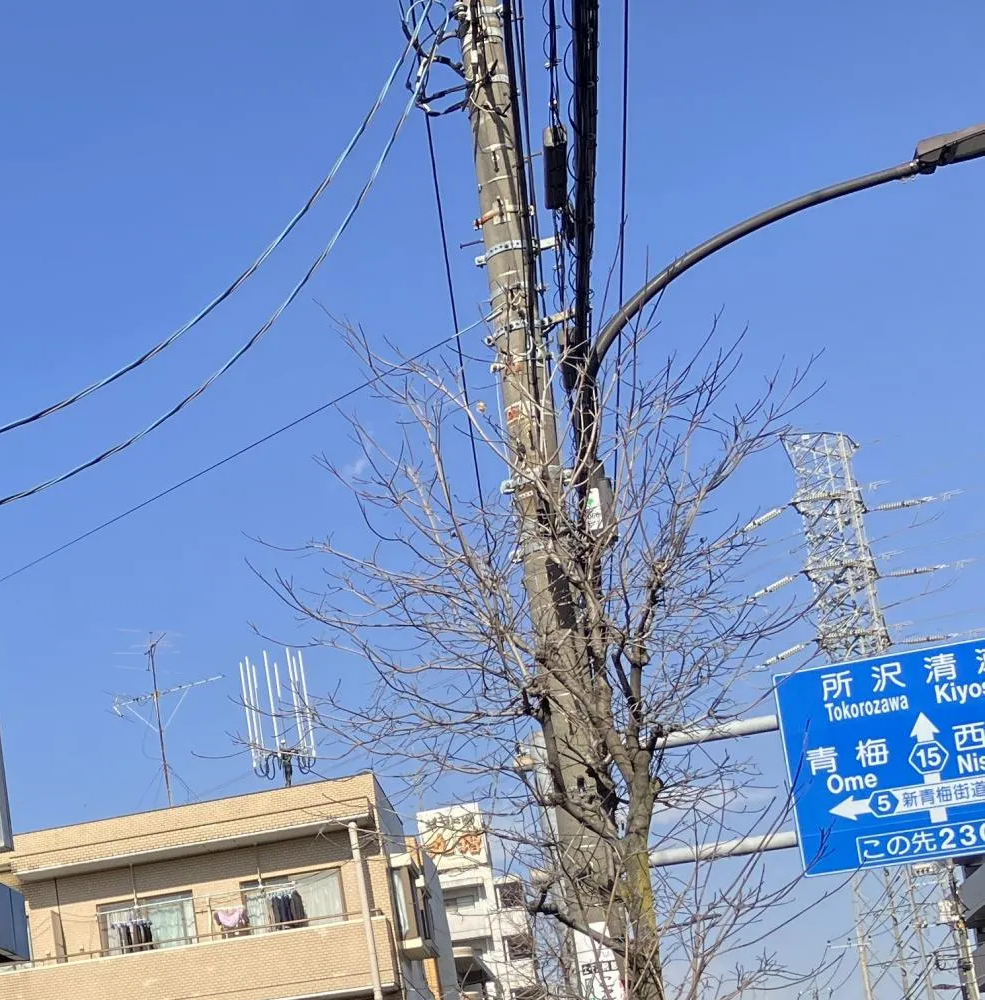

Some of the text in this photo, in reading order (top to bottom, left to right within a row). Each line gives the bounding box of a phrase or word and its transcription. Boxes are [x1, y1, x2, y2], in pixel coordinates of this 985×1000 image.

[923, 648, 985, 684] 清
[821, 662, 906, 701] 所沢
[825, 694, 908, 722] Tokorozawa
[806, 738, 889, 775] 青梅
[916, 746, 942, 768] 15
[826, 772, 878, 794] Ome
[902, 779, 985, 808] 新青梅街道
[877, 794, 891, 812] 5
